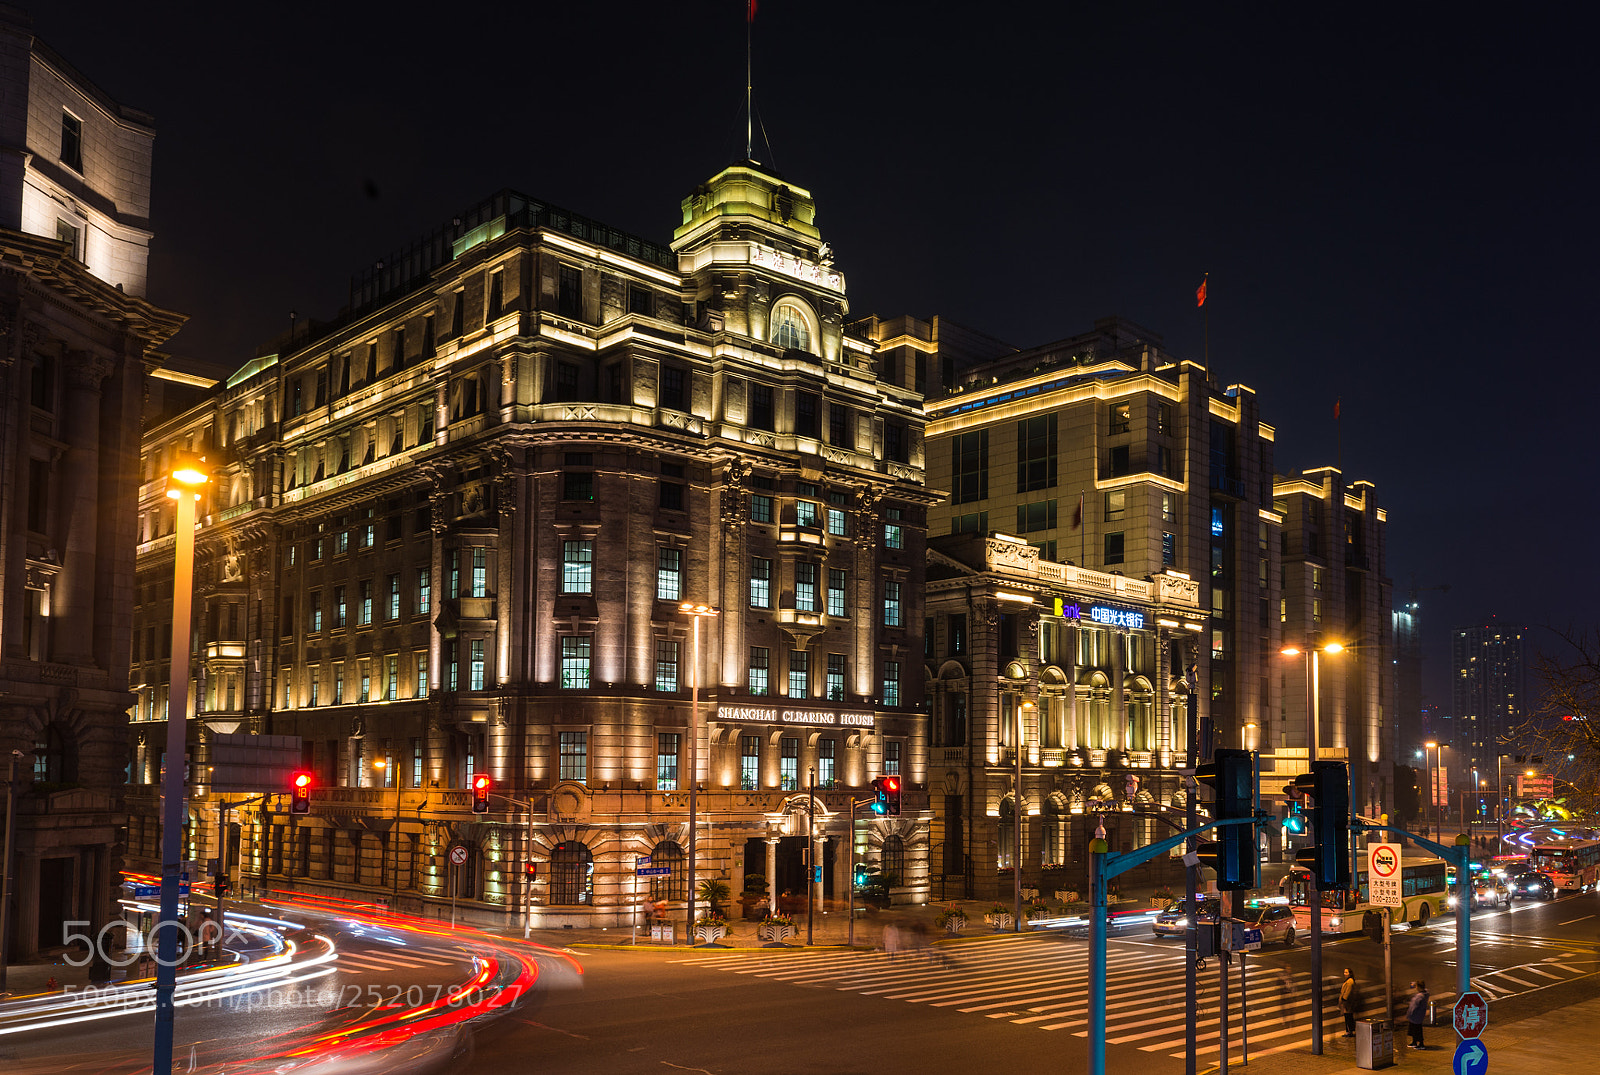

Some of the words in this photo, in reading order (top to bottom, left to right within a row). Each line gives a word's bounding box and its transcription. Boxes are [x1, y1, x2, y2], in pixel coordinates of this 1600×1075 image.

[1054, 597, 1081, 619] Bank
[1091, 606, 1144, 629] 中国光大银行
[718, 707, 777, 721] SHANGHAI
[782, 710, 835, 724] CLEARING
[840, 714, 874, 725] HOUSE
[1373, 880, 1397, 888] 大型号牌
[1462, 1004, 1480, 1030] 停
